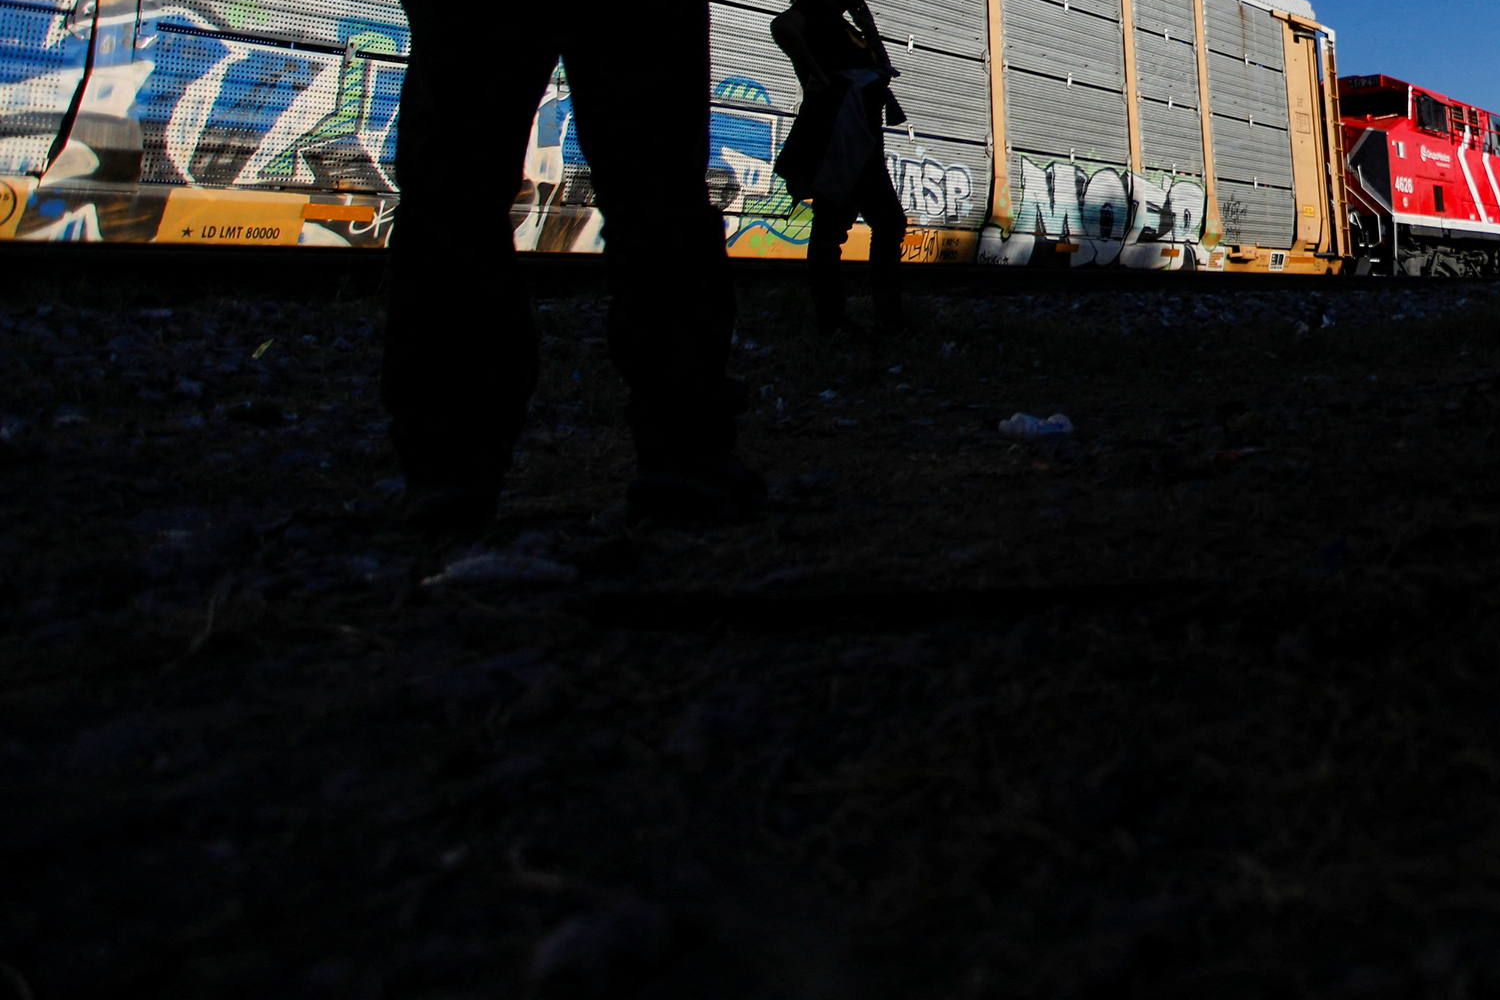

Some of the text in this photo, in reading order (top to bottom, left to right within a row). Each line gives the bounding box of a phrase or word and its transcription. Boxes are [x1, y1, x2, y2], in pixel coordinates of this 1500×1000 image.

[1395, 176, 1413, 194] 4626
[202, 226, 280, 240] LD LMT 80000
